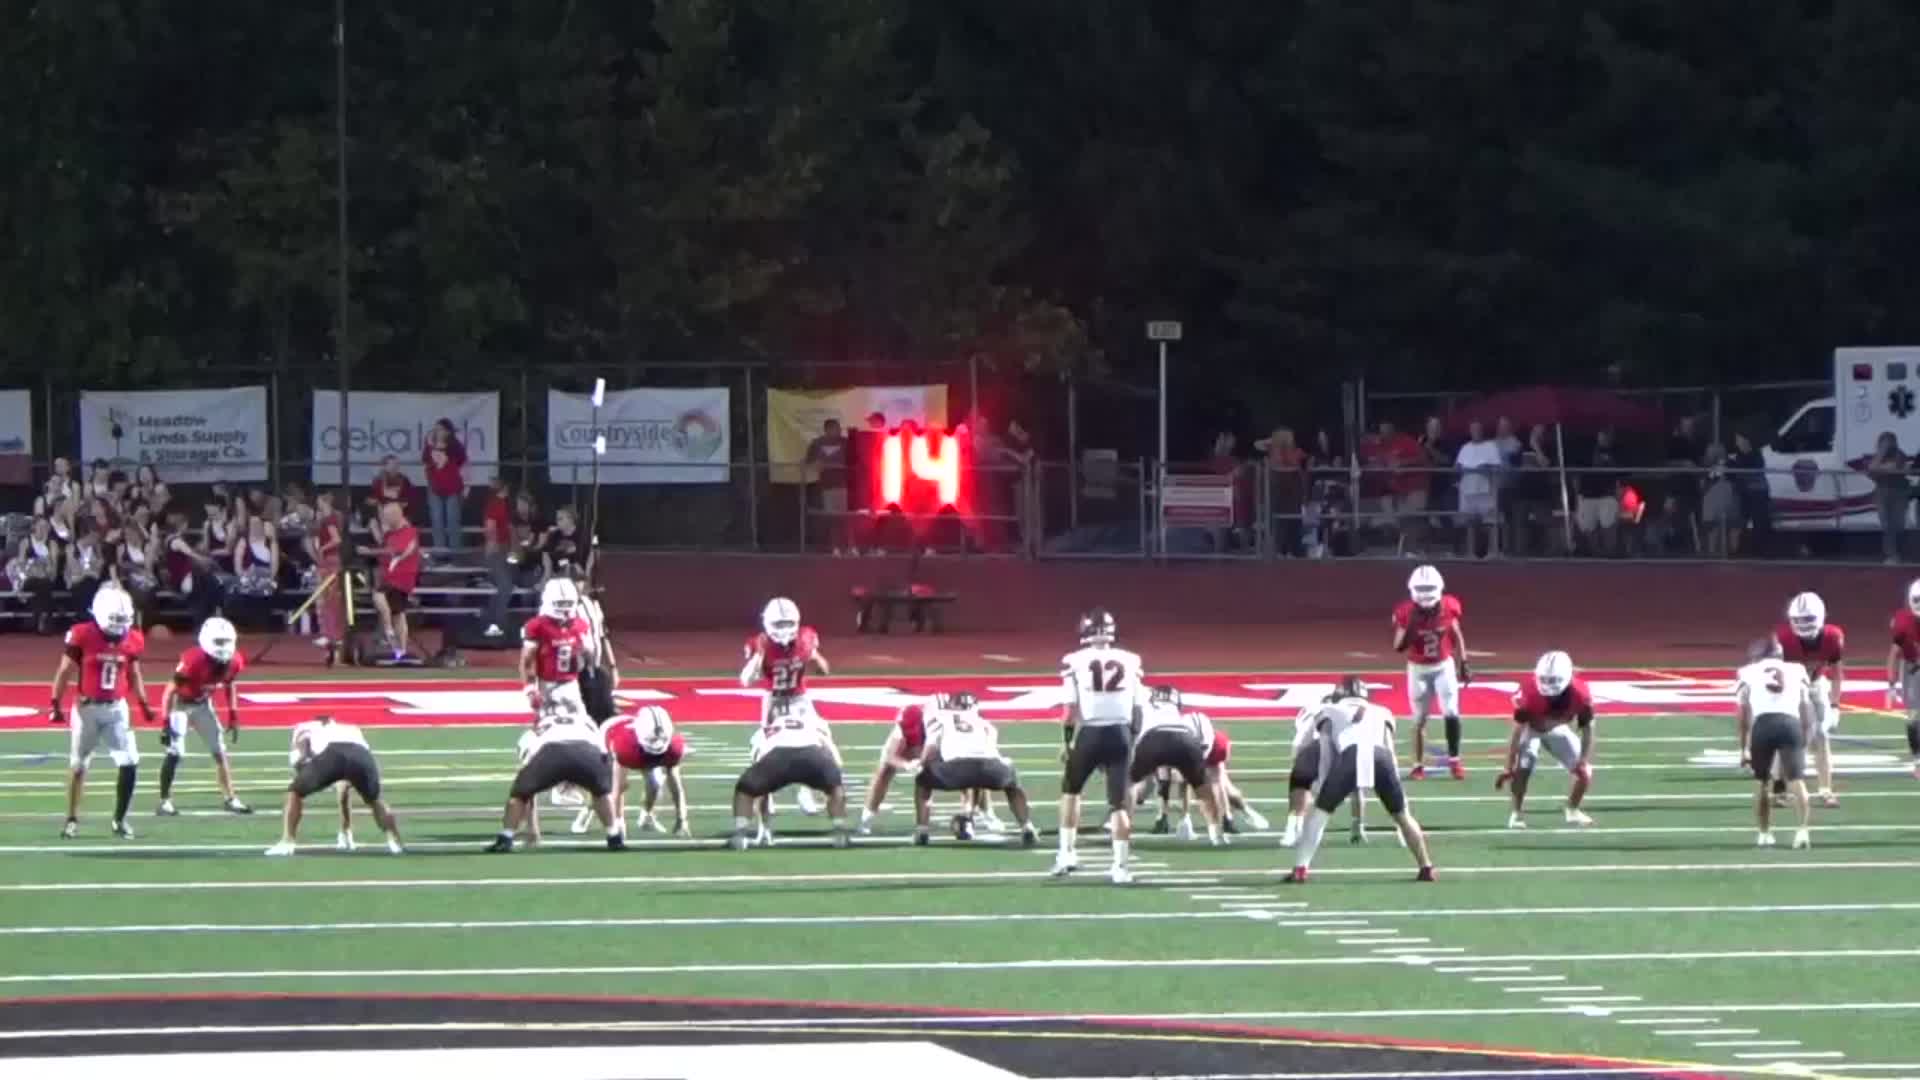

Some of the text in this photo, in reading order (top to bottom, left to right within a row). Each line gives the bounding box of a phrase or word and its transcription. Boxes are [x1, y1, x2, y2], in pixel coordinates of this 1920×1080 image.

[138, 416, 208, 427] Meadow
[139, 430, 248, 445] Lands Supply
[883, 435, 959, 504] 14
[101, 661, 117, 690] 0
[1088, 659, 1126, 692] 12
[1763, 666, 1785, 694] 3
